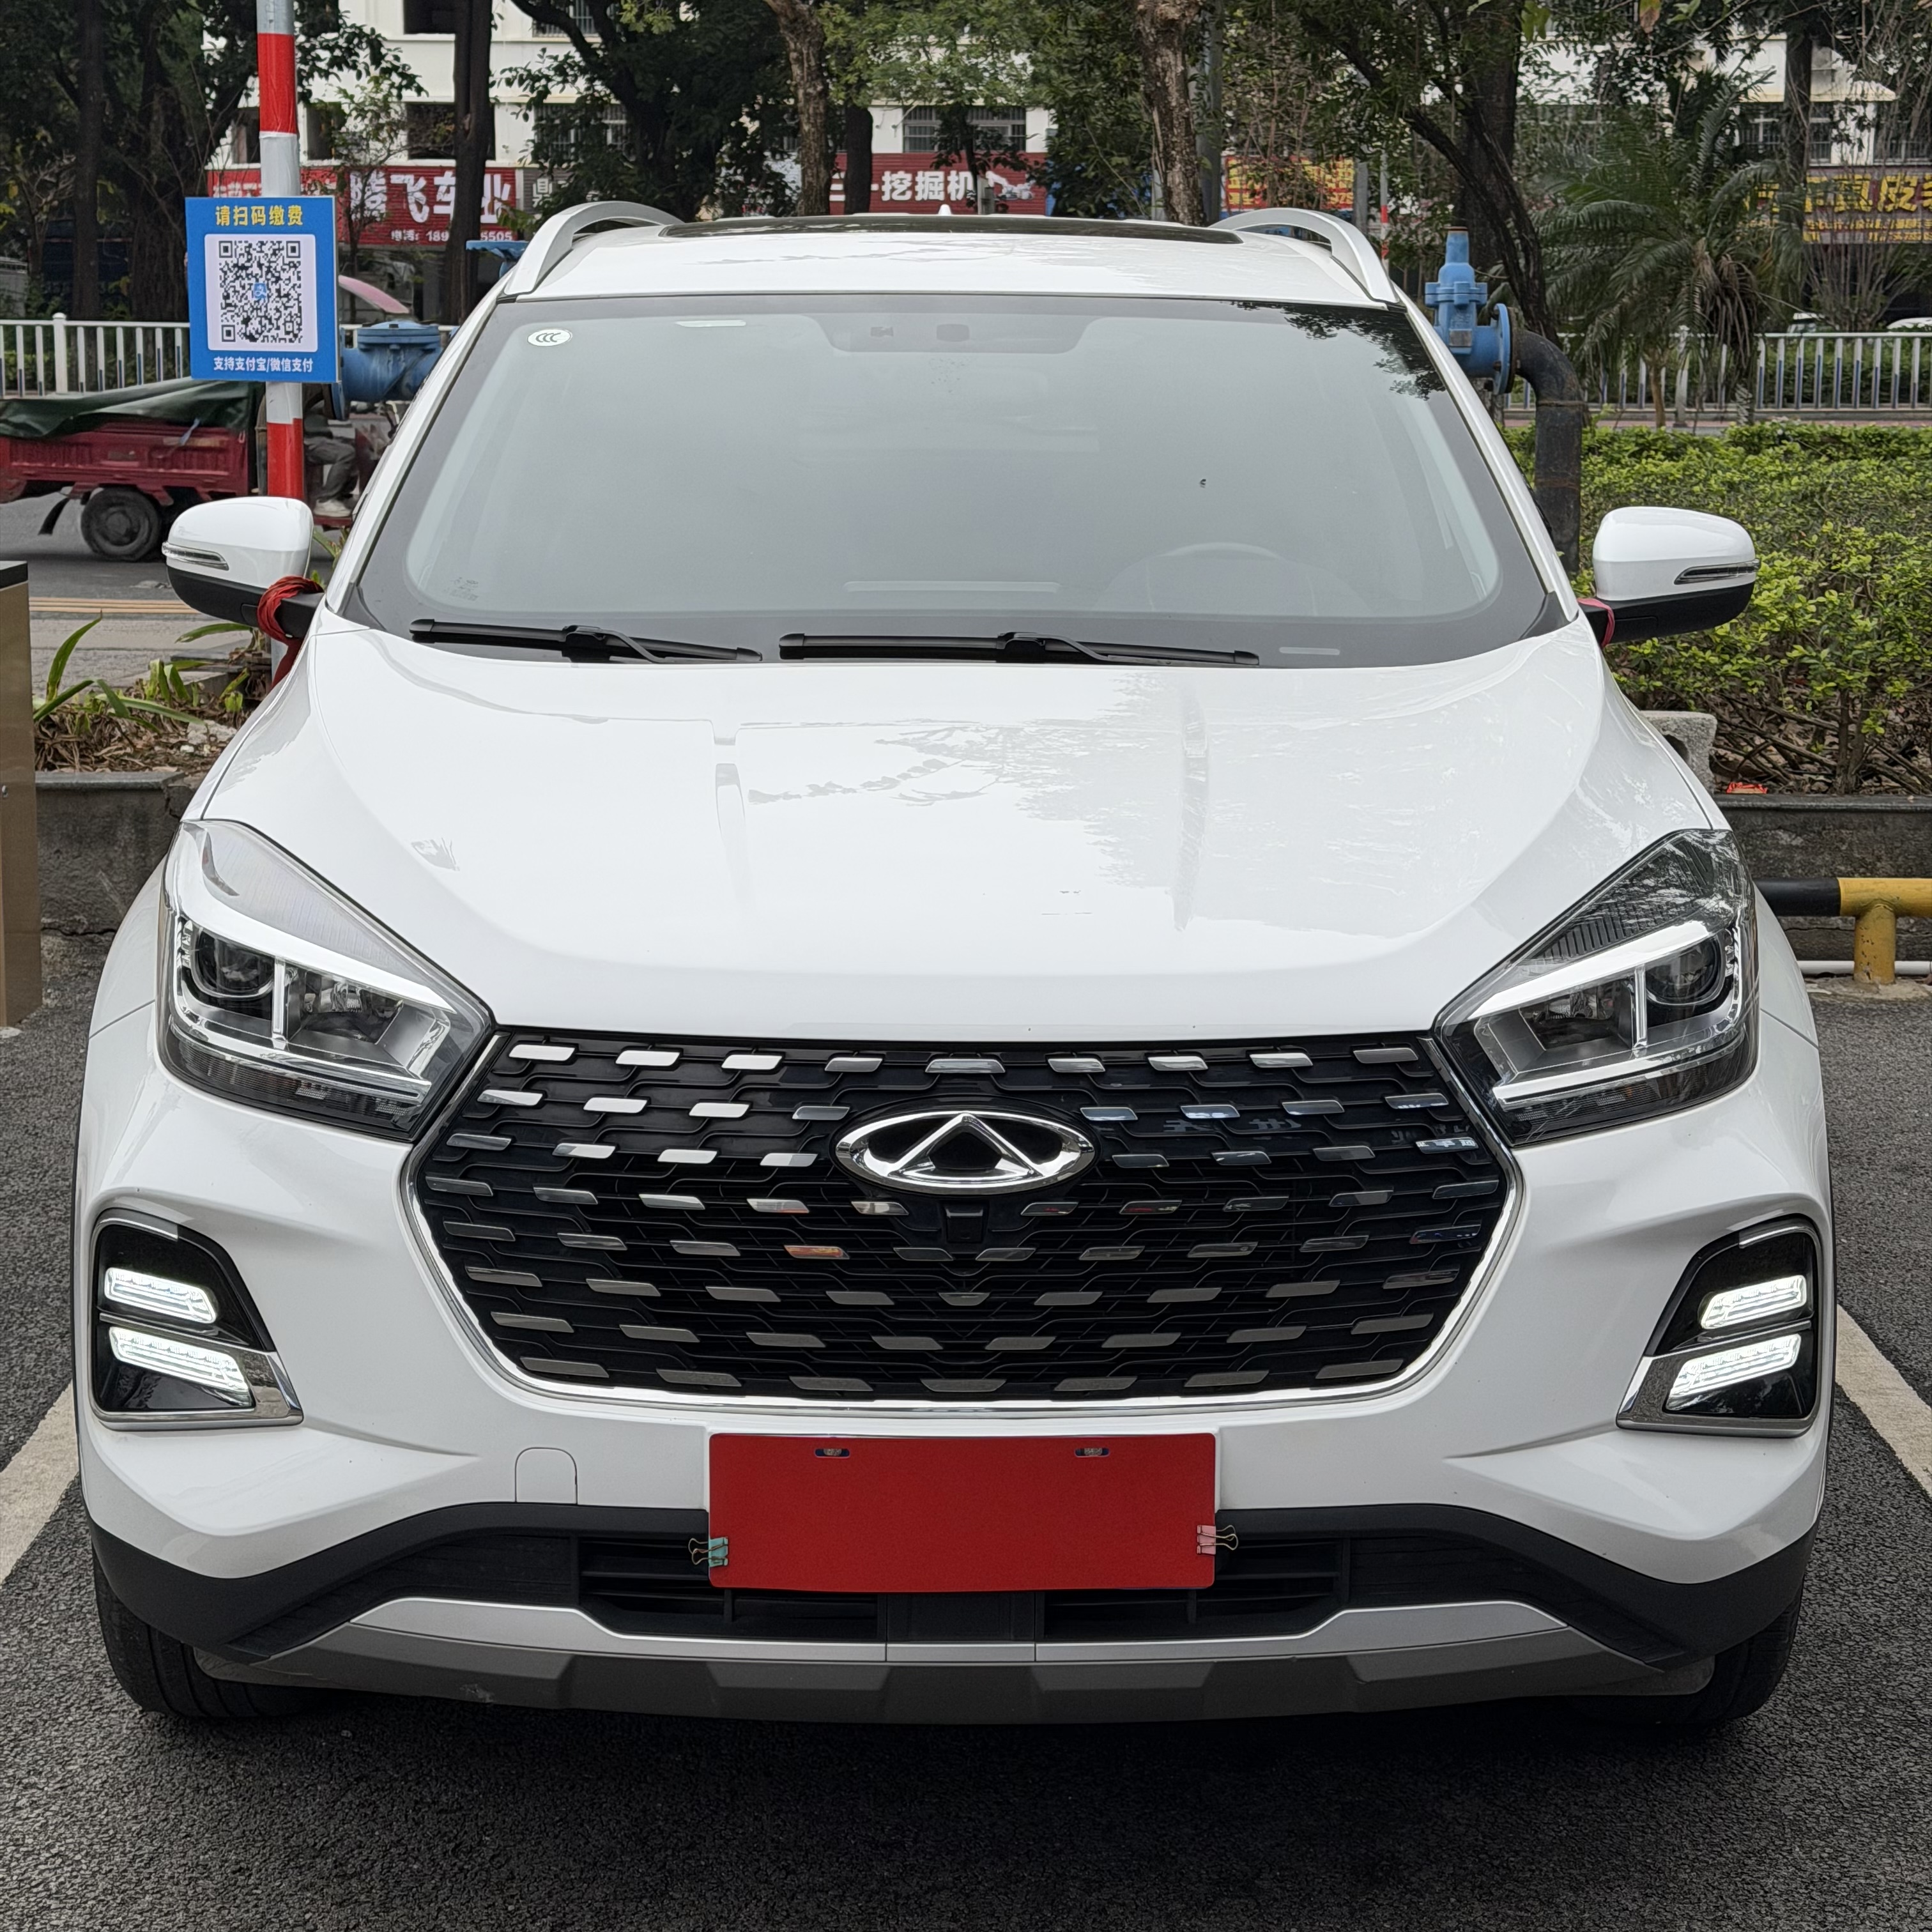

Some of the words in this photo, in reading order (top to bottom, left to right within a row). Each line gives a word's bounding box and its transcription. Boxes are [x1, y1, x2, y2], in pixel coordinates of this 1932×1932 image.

[215, 205, 303, 226] 请扫码缴费
[213, 356, 313, 372] 支持支付宝/微信支付
